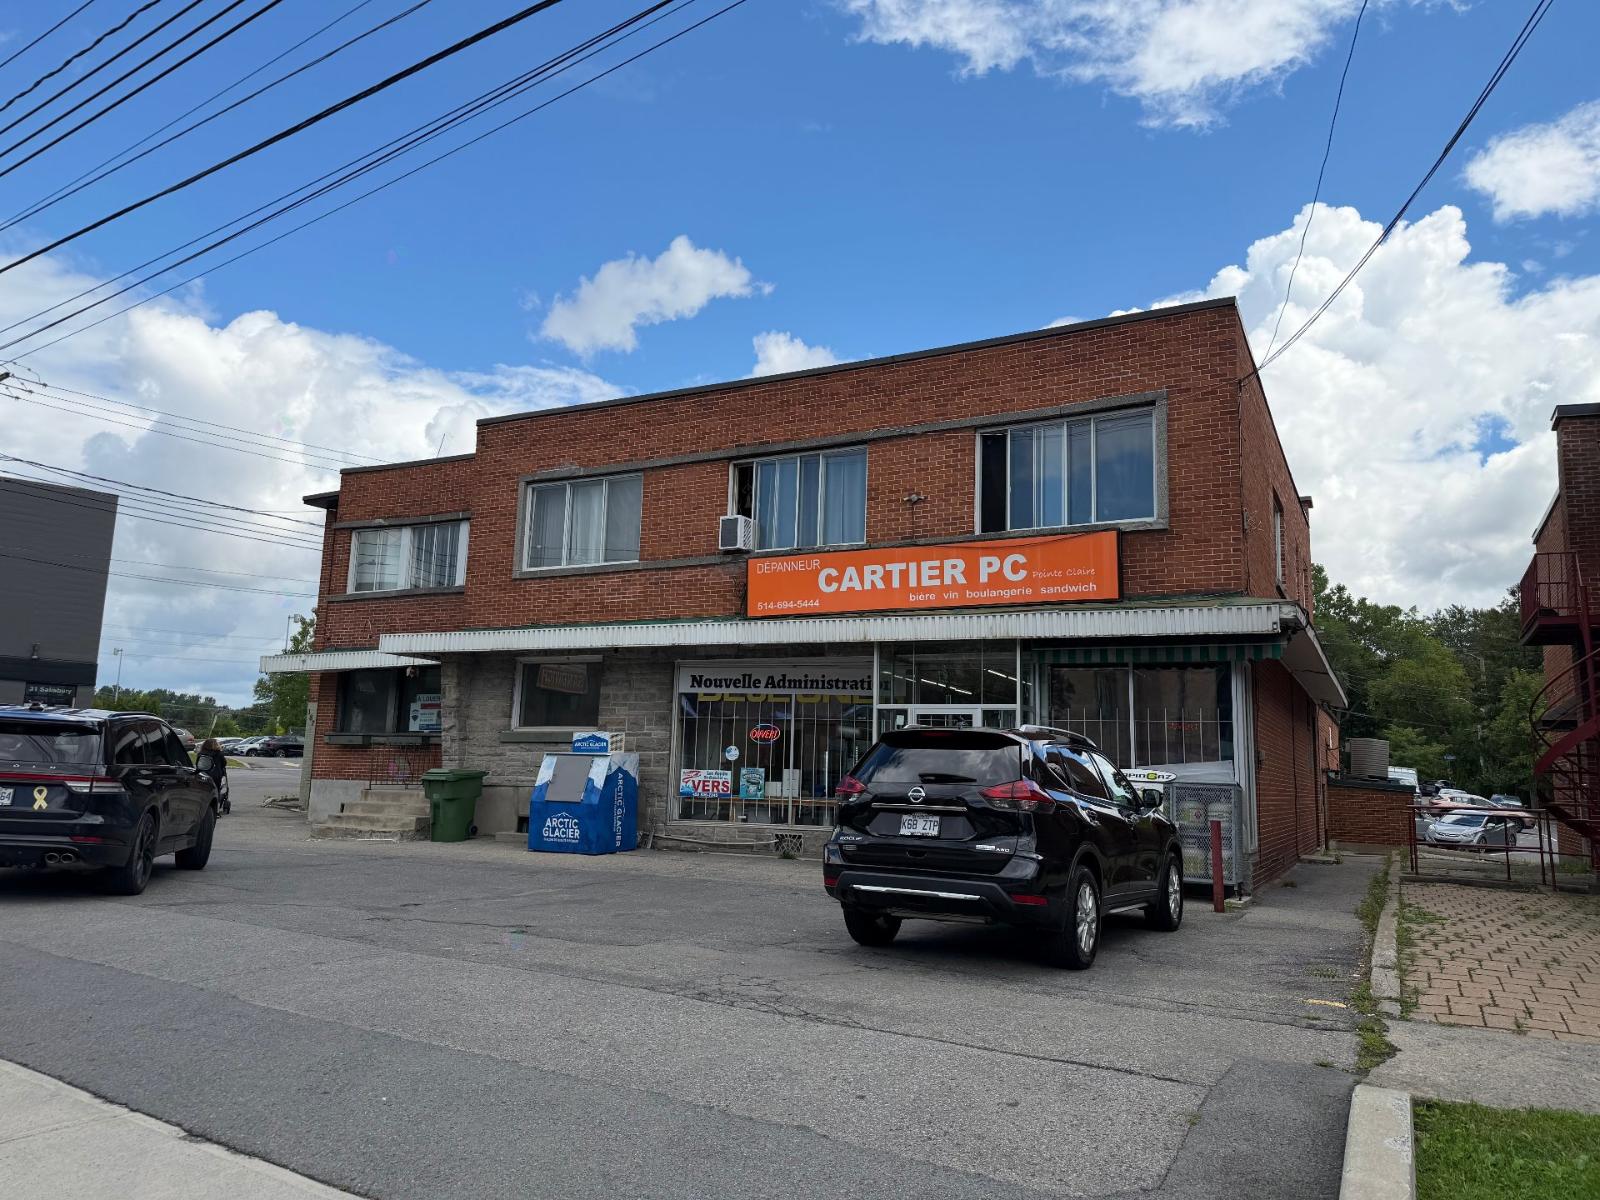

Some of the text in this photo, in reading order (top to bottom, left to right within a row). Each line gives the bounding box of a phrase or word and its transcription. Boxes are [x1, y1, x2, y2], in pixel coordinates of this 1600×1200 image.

[756, 559, 820, 574] DÉPANNEUR
[817, 553, 1028, 593] CARTIER PC
[1066, 567, 1096, 577] Claire
[908, 582, 1097, 602] bière vin boulangerie sandwich
[757, 599, 820, 611] 514-694-5444
[690, 673, 890, 690] Nouvelle Administrati
[692, 779, 730, 793] VERS
[545, 818, 578, 829] ARCTIC
[615, 808, 624, 848] GLACIER
[902, 819, 939, 831] K68 ZTP
[542, 827, 580, 839] GLACIER
